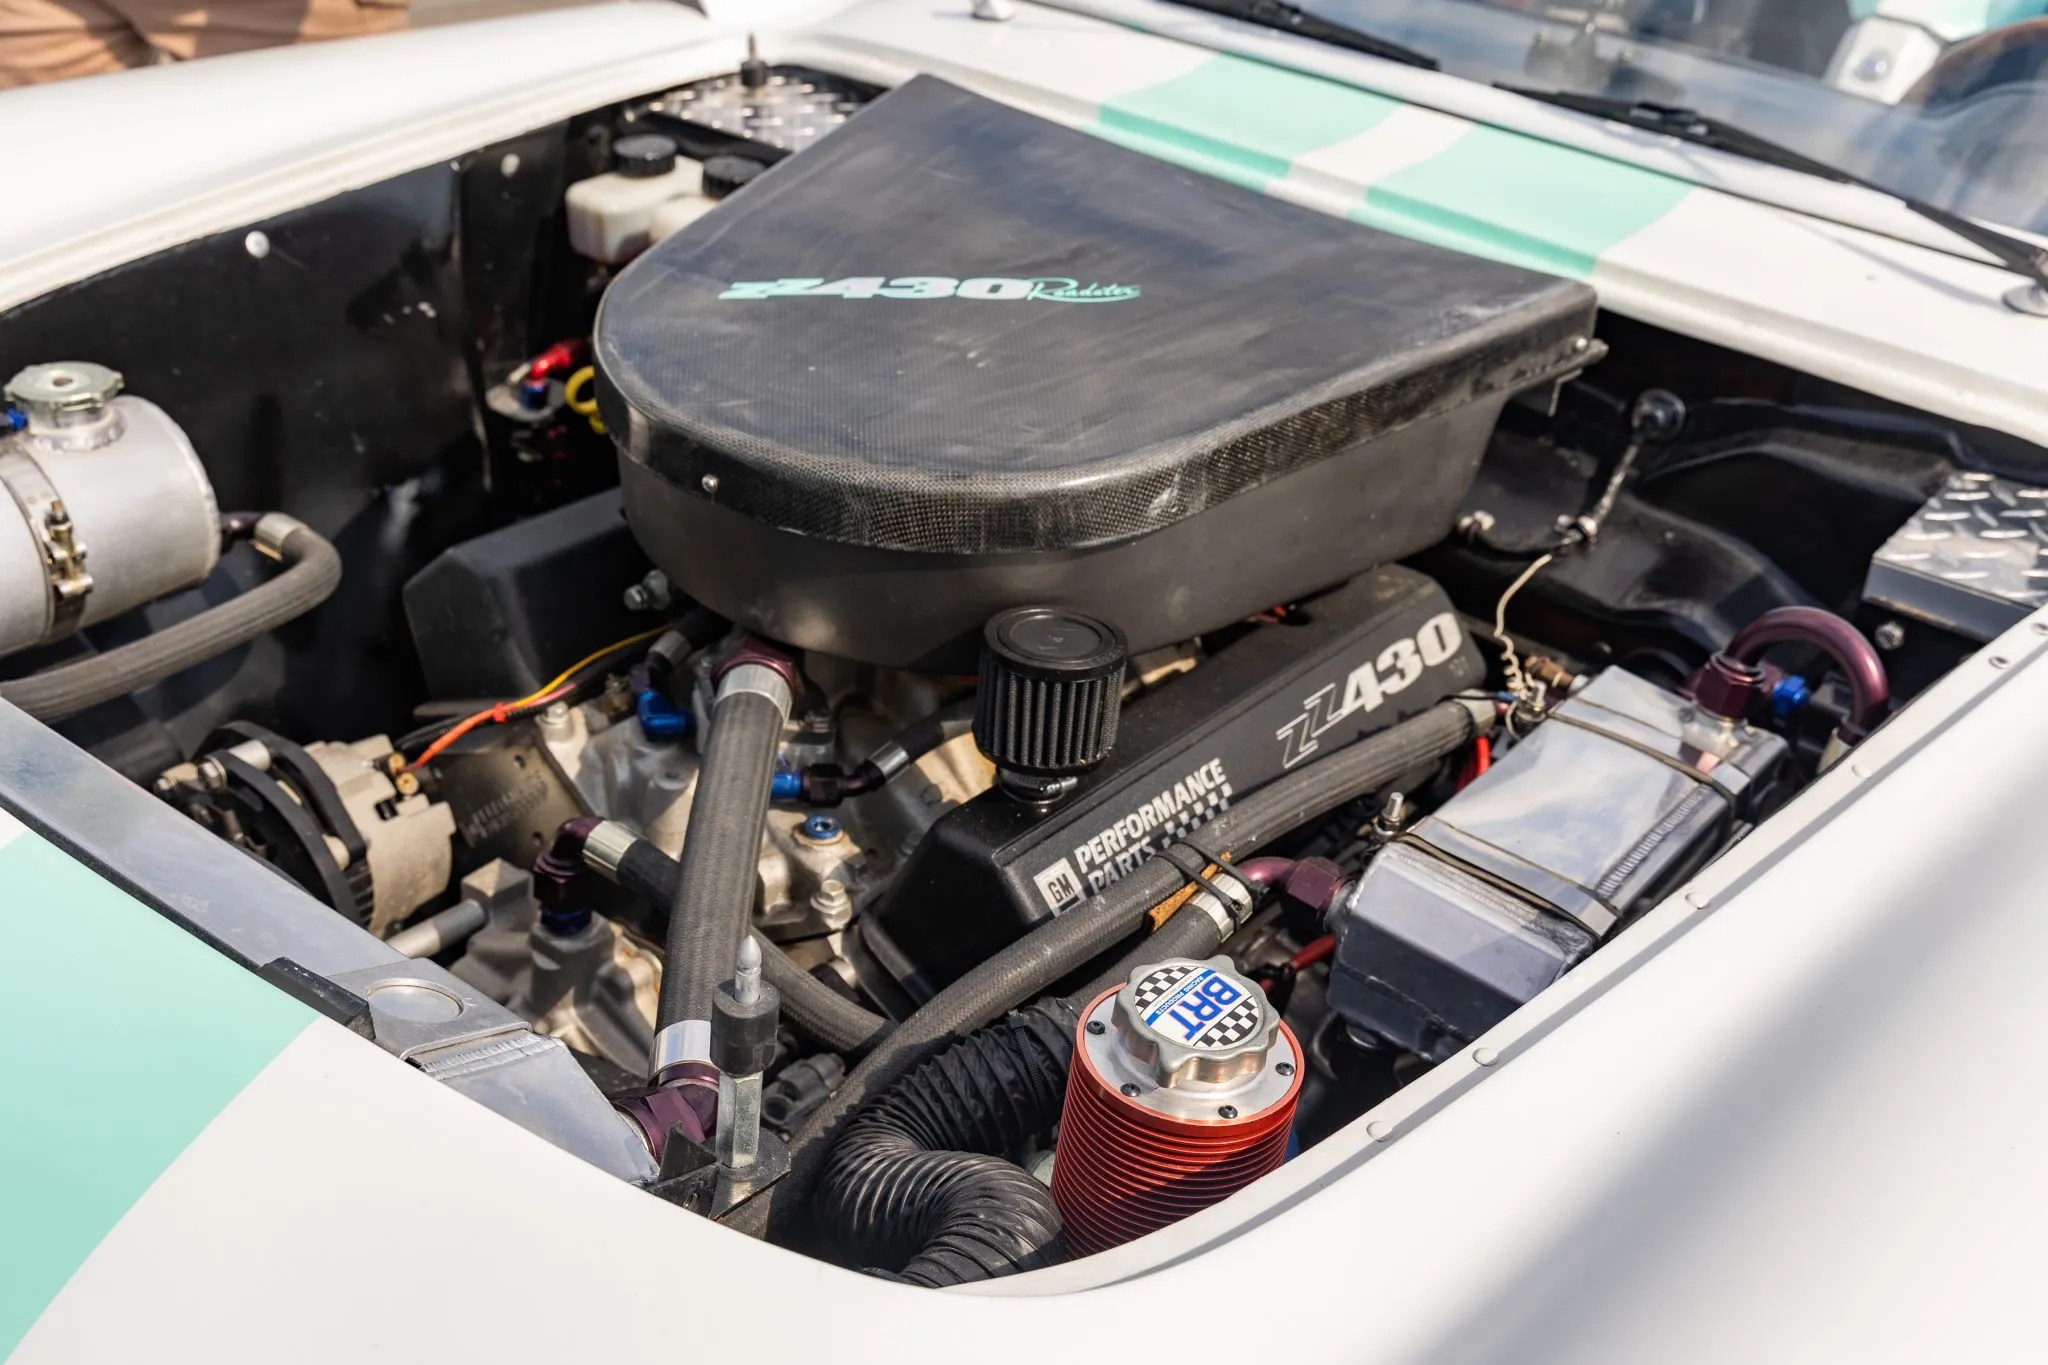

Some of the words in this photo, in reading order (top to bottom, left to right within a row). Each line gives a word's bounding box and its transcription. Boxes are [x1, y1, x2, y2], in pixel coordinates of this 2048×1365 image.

[718, 276, 1033, 300] ZZ430
[1027, 276, 1141, 303] Roadster
[1276, 612, 1463, 769] ZZ430
[1074, 758, 1227, 874] PERFORMANCE
[1047, 872, 1076, 904] GM
[1087, 836, 1157, 895] PARTS
[1155, 991, 1185, 1015] PRODUCTS
[1182, 975, 1205, 993] RACING
[1167, 975, 1242, 1041] BRT
